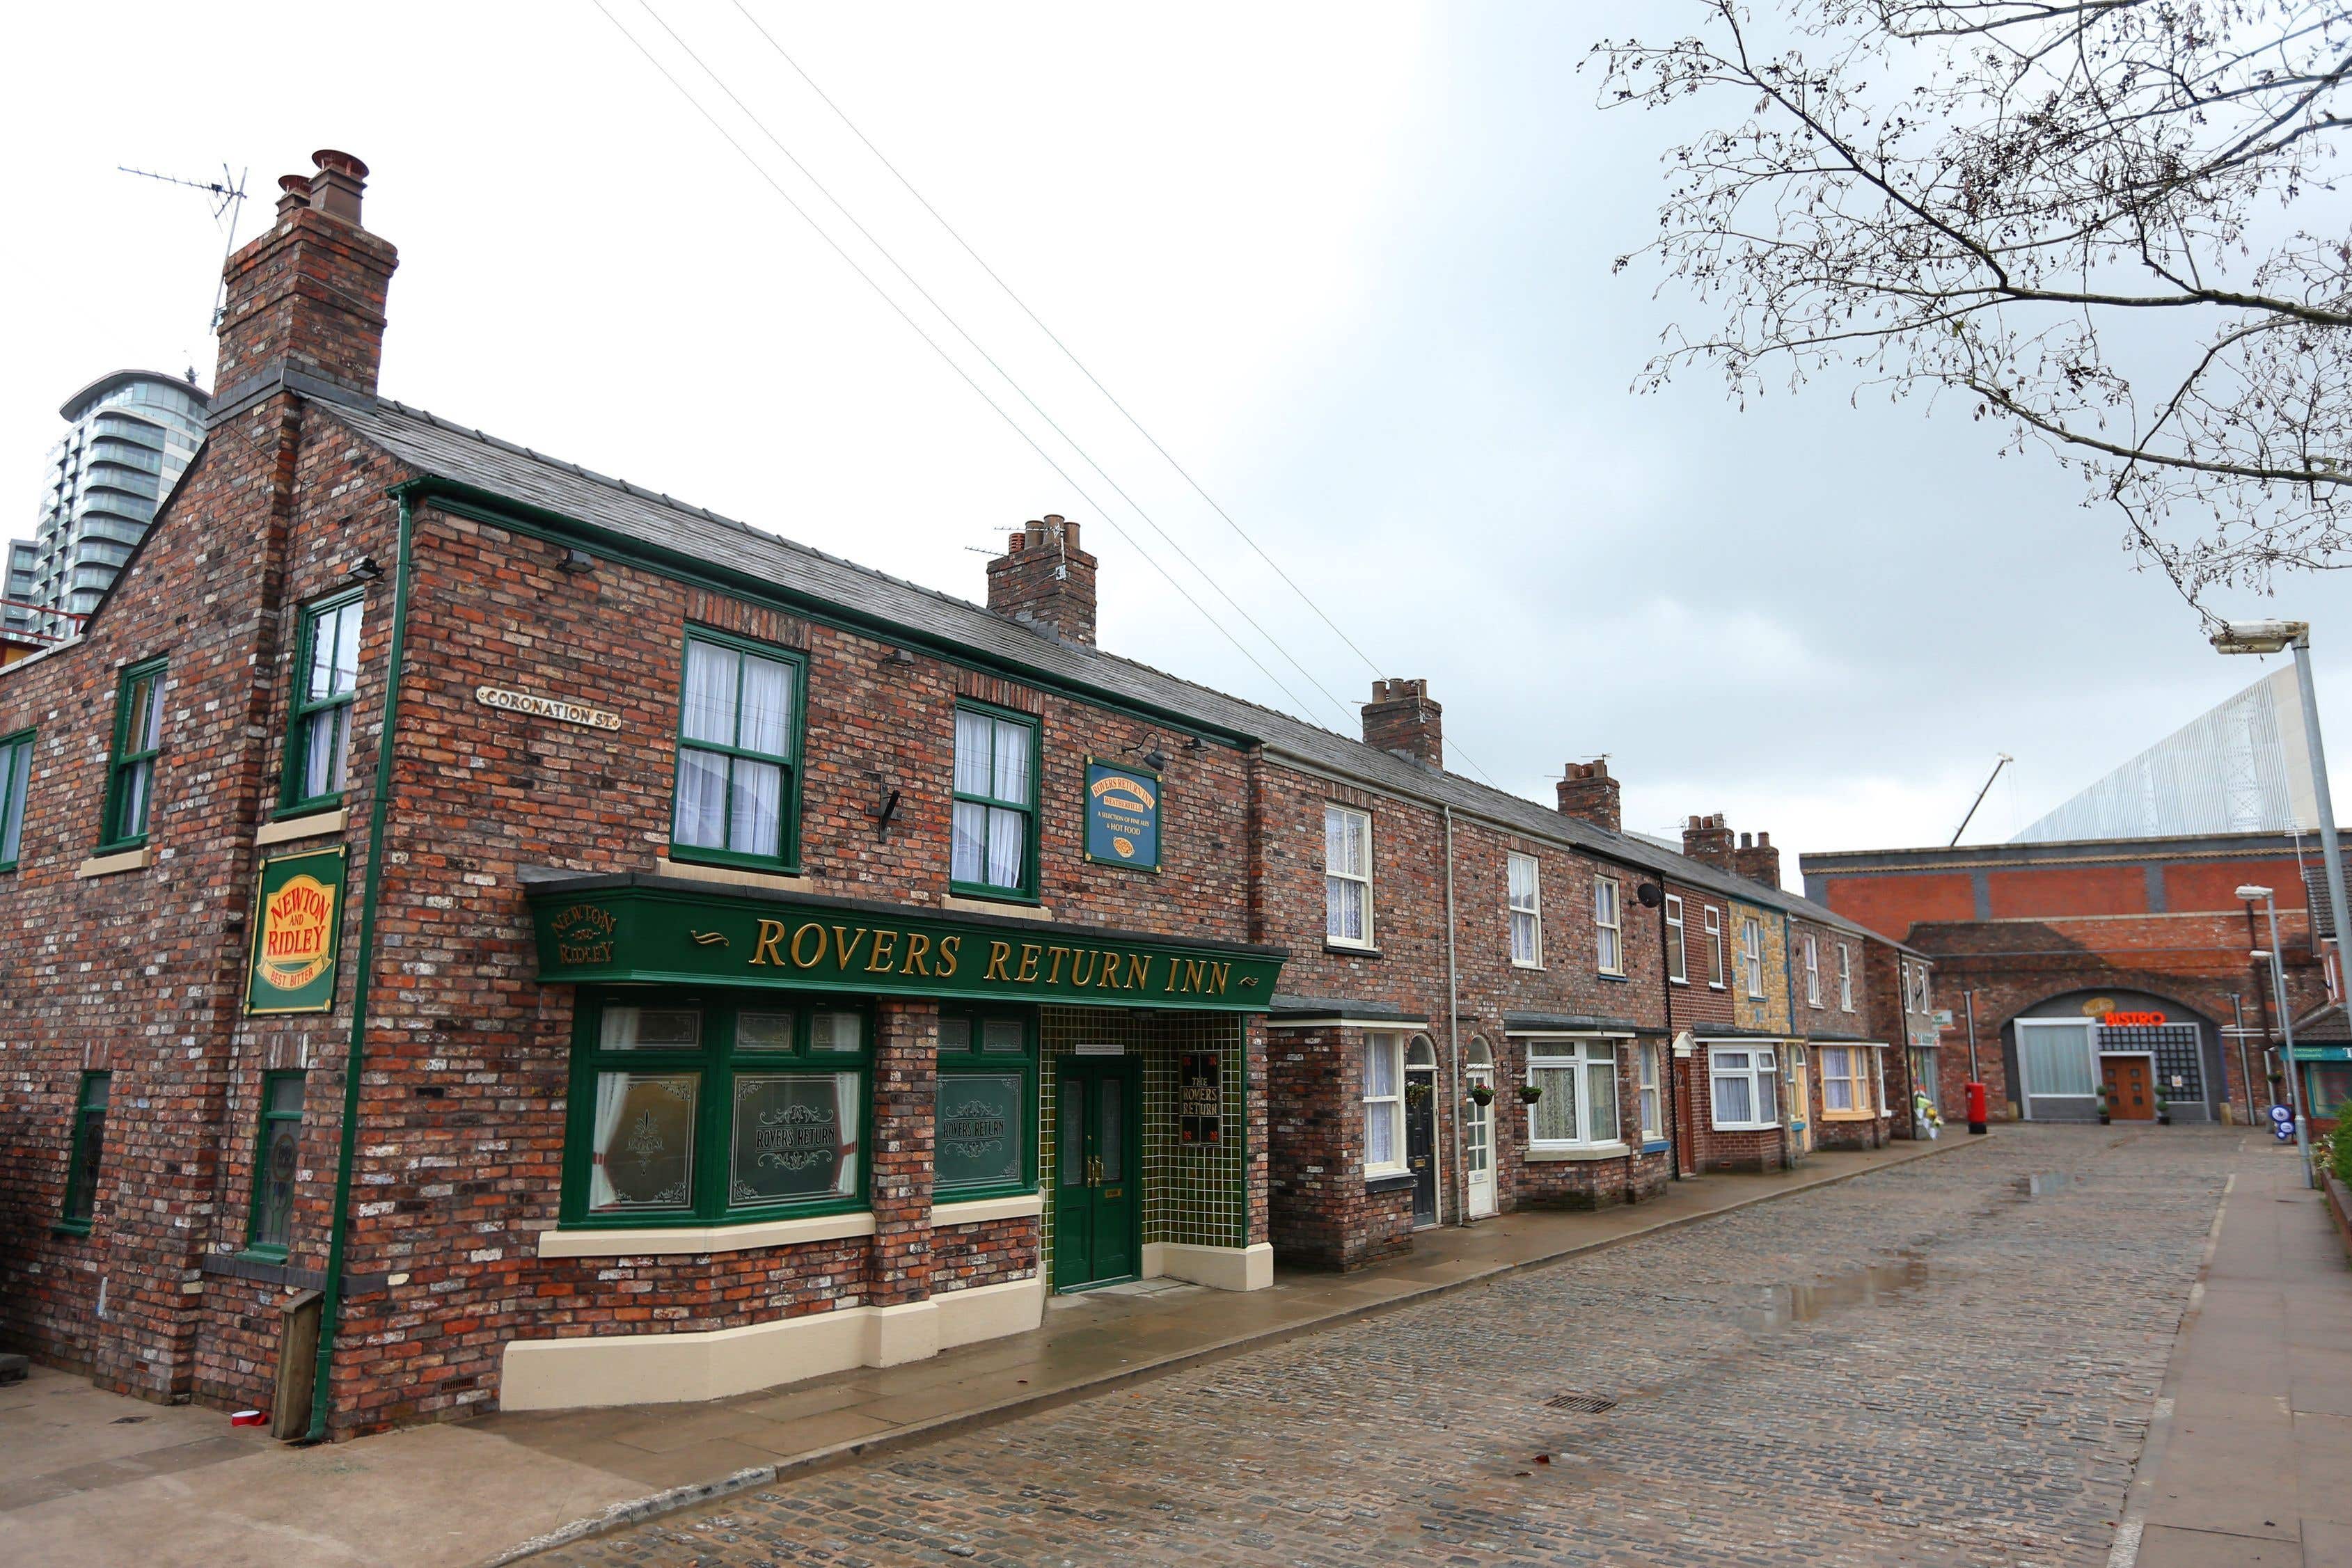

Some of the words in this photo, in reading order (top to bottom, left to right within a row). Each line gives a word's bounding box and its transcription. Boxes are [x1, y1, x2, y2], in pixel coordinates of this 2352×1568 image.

[487, 690, 590, 722] CORONATION
[594, 713, 613, 728] ST.
[1092, 778, 1117, 797] ROVERS
[1118, 778, 1142, 796] RETURN
[1141, 789, 1153, 807] INN
[1105, 796, 1142, 811] WEATHERFIELD
[1101, 811, 1123, 821] SELECTION
[1140, 818, 1150, 827] ALES
[1110, 823, 1123, 832] HOT
[1124, 825, 1141, 835] FOOD
[270, 887, 331, 929] NEWTON
[289, 914, 304, 926] AND
[551, 904, 616, 938] NEWTON
[267, 925, 326, 957] RIDLEY
[559, 941, 613, 963] RIDLEY
[748, 919, 961, 977] ROVERS
[983, 940, 1153, 990] RETURN
[1165, 958, 1231, 995] INN
[270, 969, 286, 987] BEST
[290, 966, 313, 987] BITTER
[2105, 1011, 2165, 1027] BISTRO
[1192, 1077, 1208, 1086] THE
[1183, 1088, 1217, 1100] ROVERS
[1183, 1102, 1217, 1115] RETURN
[757, 1128, 794, 1148] ROVERS
[797, 1127, 835, 1147] RETURN
[943, 1122, 972, 1138] ROVERS
[974, 1120, 1004, 1137] RETURN
